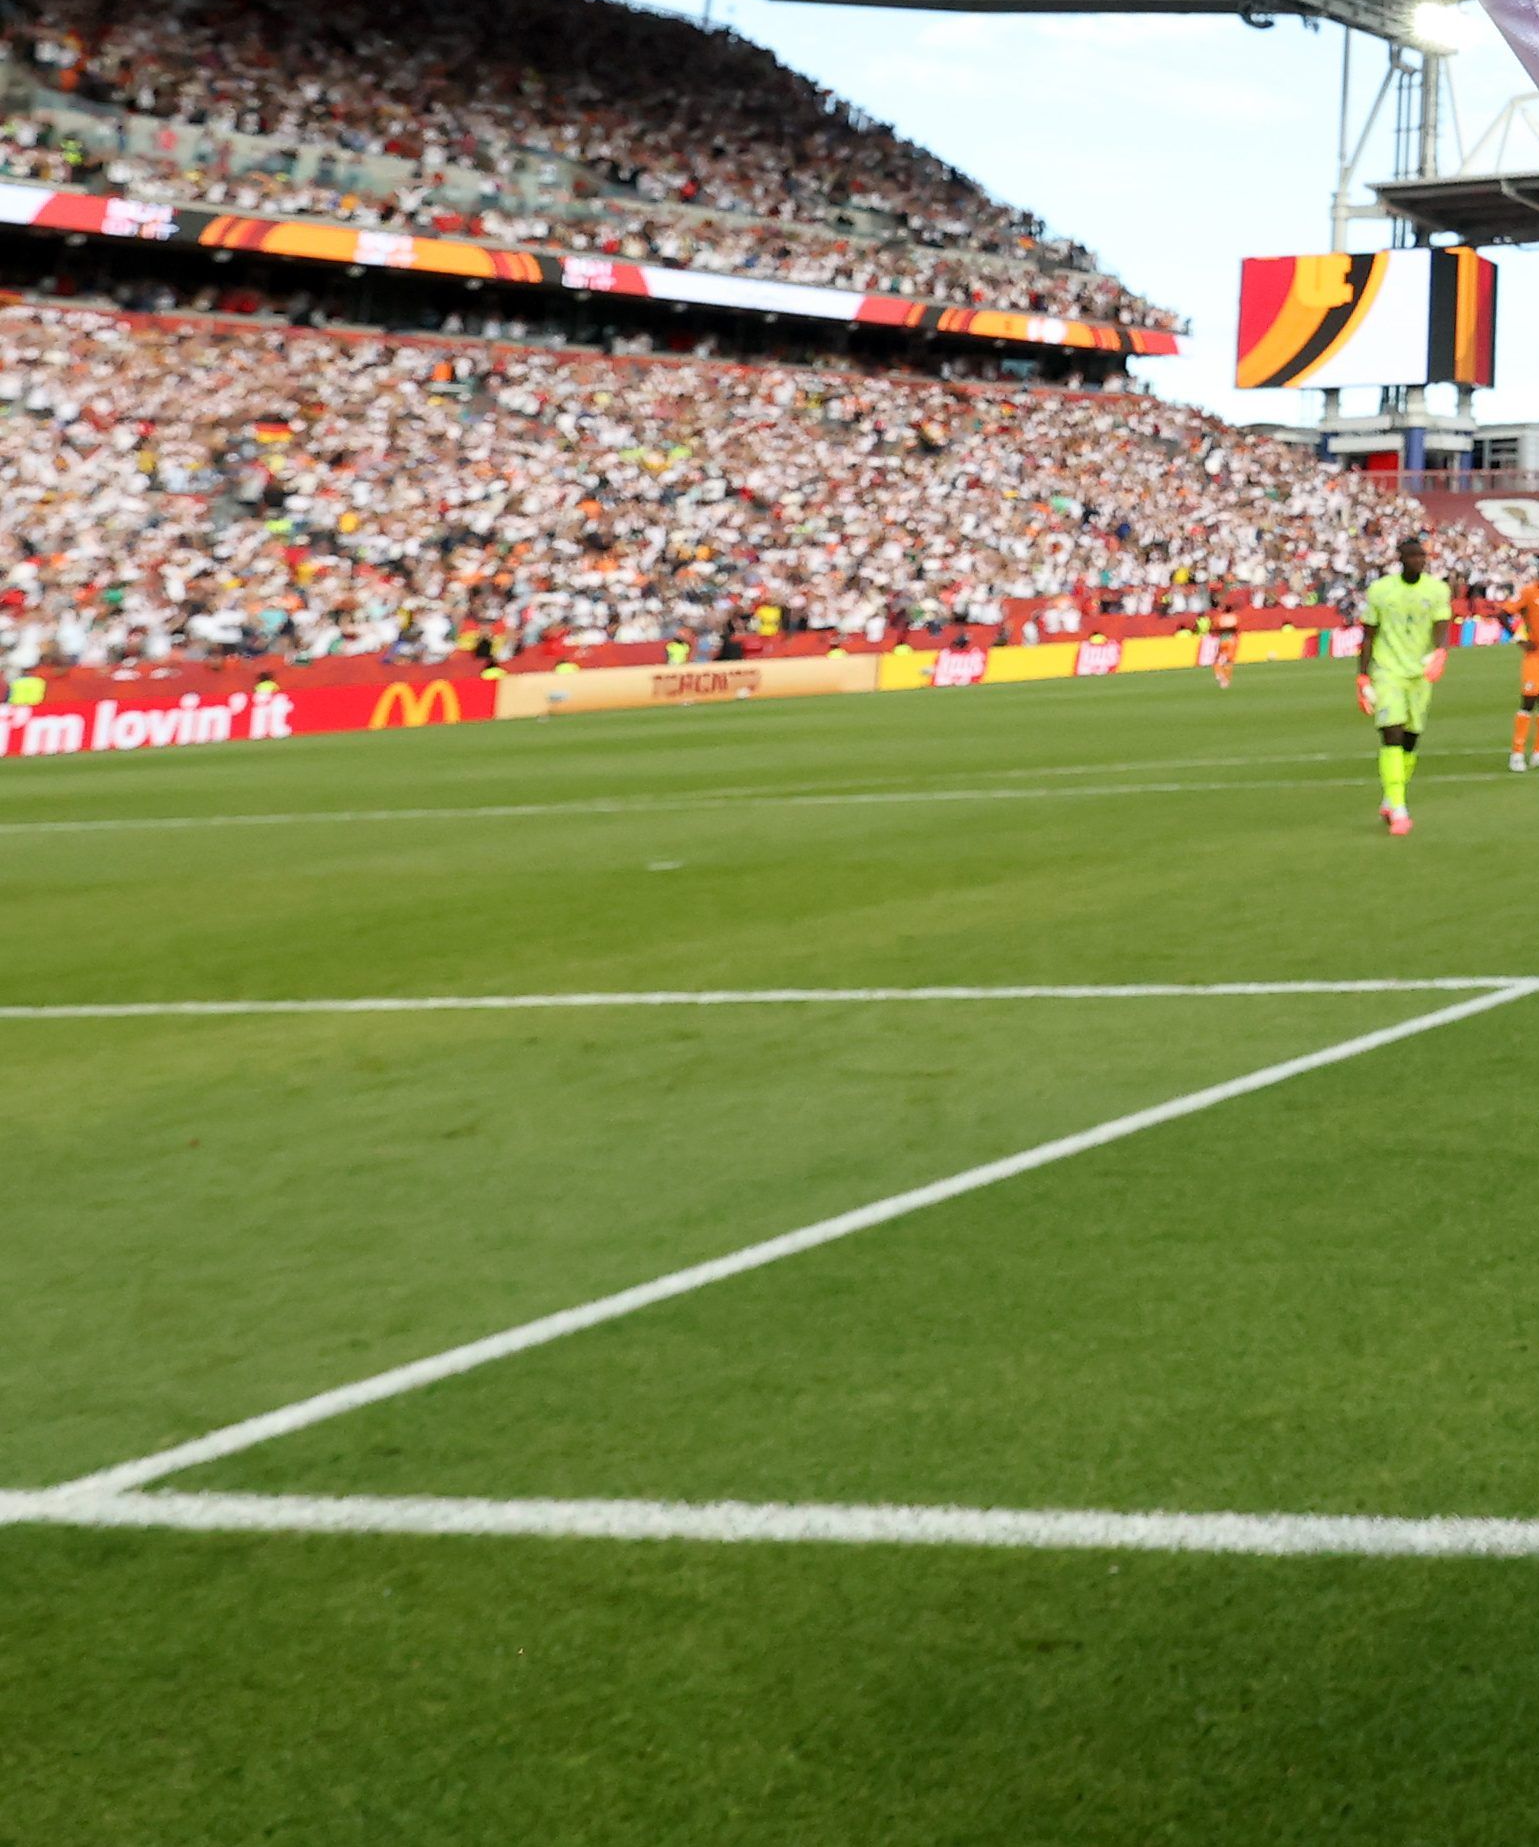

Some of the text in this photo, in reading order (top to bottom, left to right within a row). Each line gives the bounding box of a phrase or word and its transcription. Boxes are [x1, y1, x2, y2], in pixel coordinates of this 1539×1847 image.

[0, 691, 294, 756] i'm lovin' it
